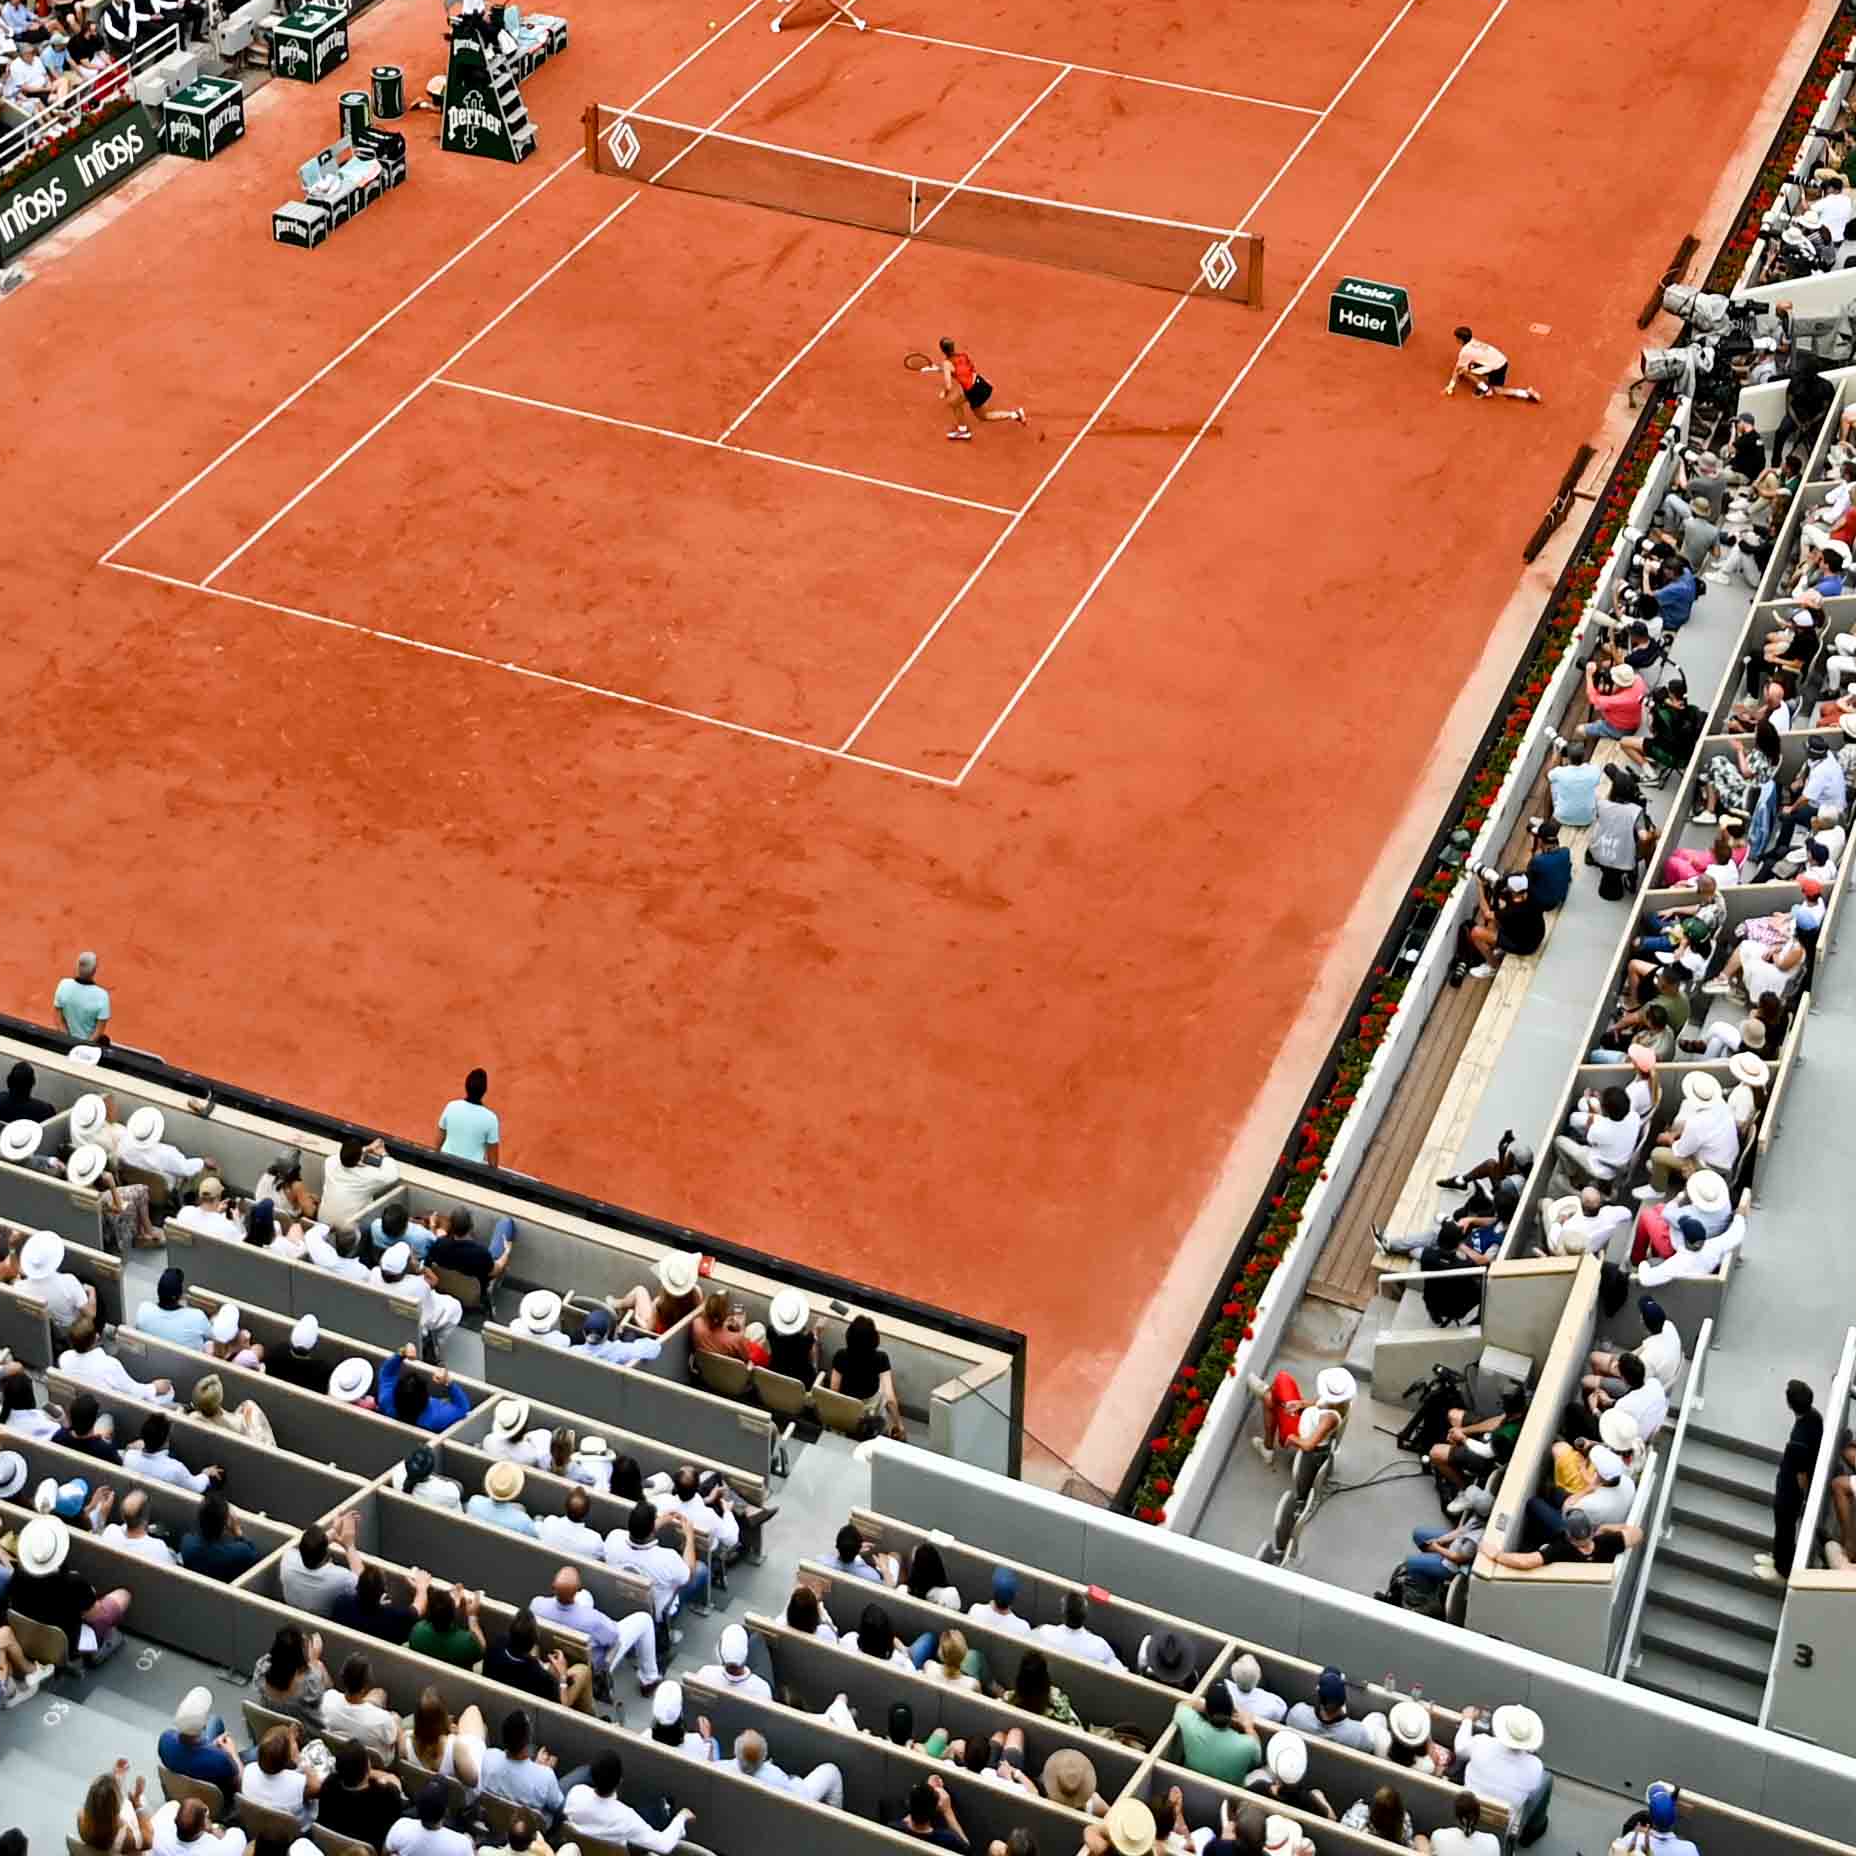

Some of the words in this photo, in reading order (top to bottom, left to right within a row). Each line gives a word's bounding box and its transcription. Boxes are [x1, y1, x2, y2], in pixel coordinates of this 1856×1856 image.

[74, 124, 144, 187] Infosys
[1345, 282, 1395, 302] Haier
[1338, 308, 1387, 333] Haier
[1794, 1644, 1814, 1668] 3
